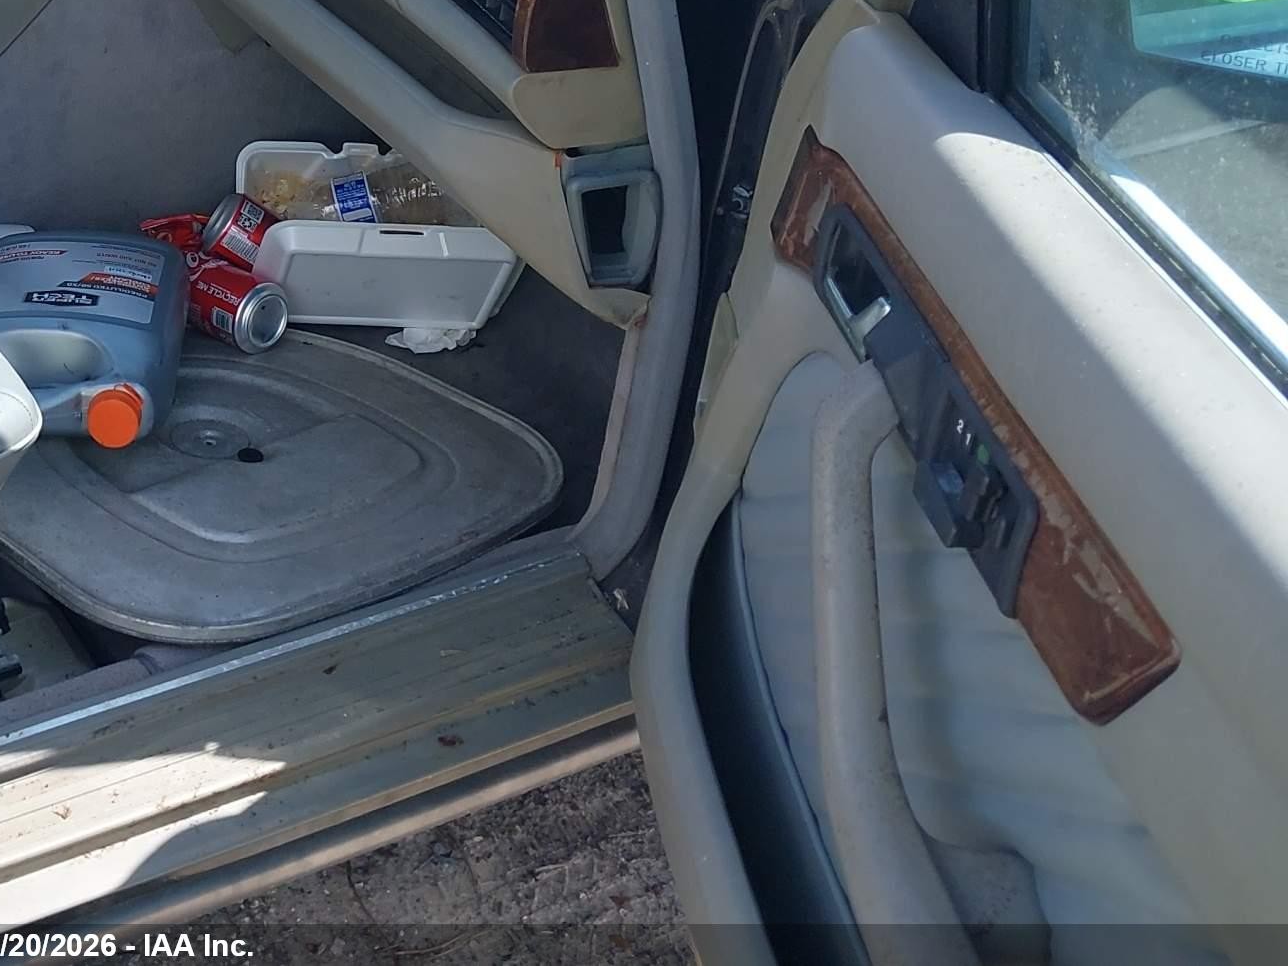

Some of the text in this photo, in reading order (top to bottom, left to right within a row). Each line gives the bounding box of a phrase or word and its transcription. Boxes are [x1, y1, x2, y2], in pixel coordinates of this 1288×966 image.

[1201, 50, 1267, 71] CLOSER
[196, 281, 242, 306] RECYCLE ME
[956, 419, 971, 445] 2 1
